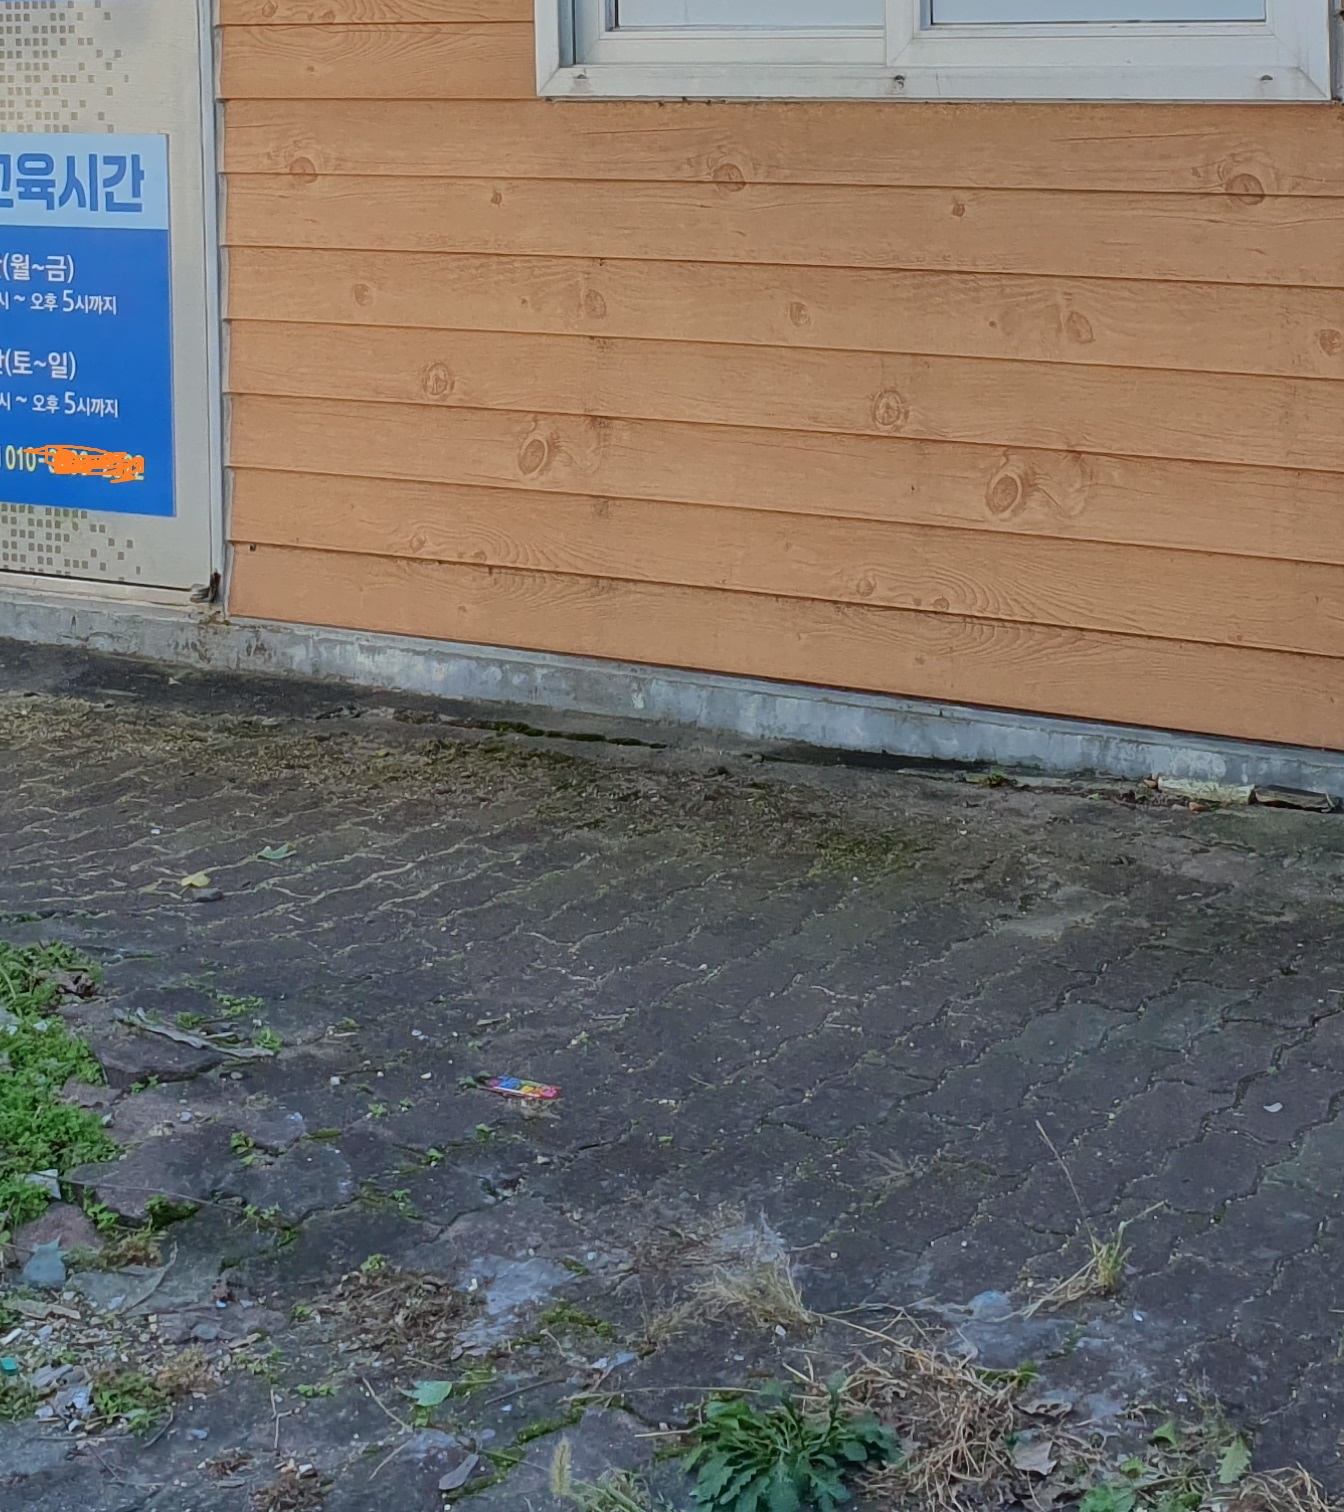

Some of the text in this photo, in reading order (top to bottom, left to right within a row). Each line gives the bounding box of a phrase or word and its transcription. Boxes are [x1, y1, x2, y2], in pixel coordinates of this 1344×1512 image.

[31, 292, 58, 312] 오후
[62, 290, 117, 315] 5시까지
[32, 393, 59, 414] 오후
[64, 393, 118, 417] 5시까지
